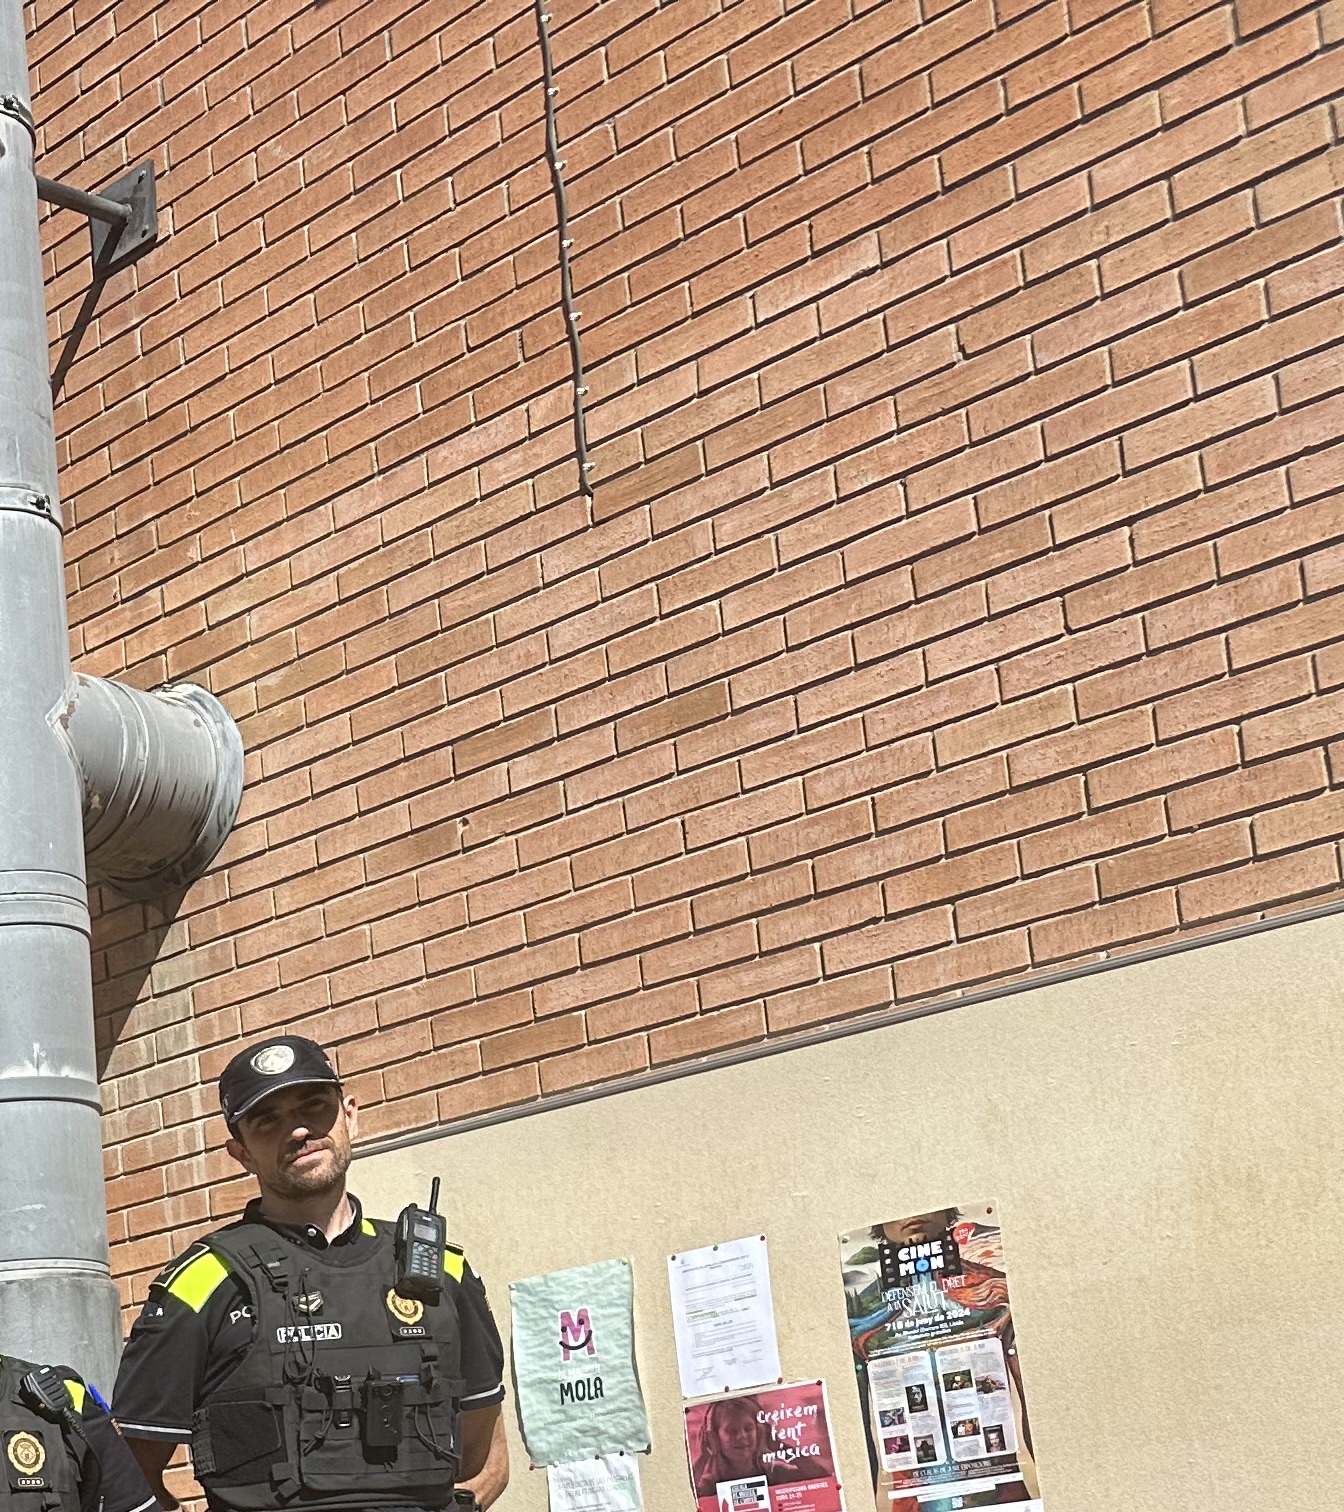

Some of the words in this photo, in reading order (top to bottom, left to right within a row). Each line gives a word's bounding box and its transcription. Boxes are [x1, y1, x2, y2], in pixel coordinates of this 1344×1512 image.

[897, 1240, 943, 1261] CINE
[946, 1308, 970, 1320] 2024
[560, 1376, 604, 1406] MOLA
